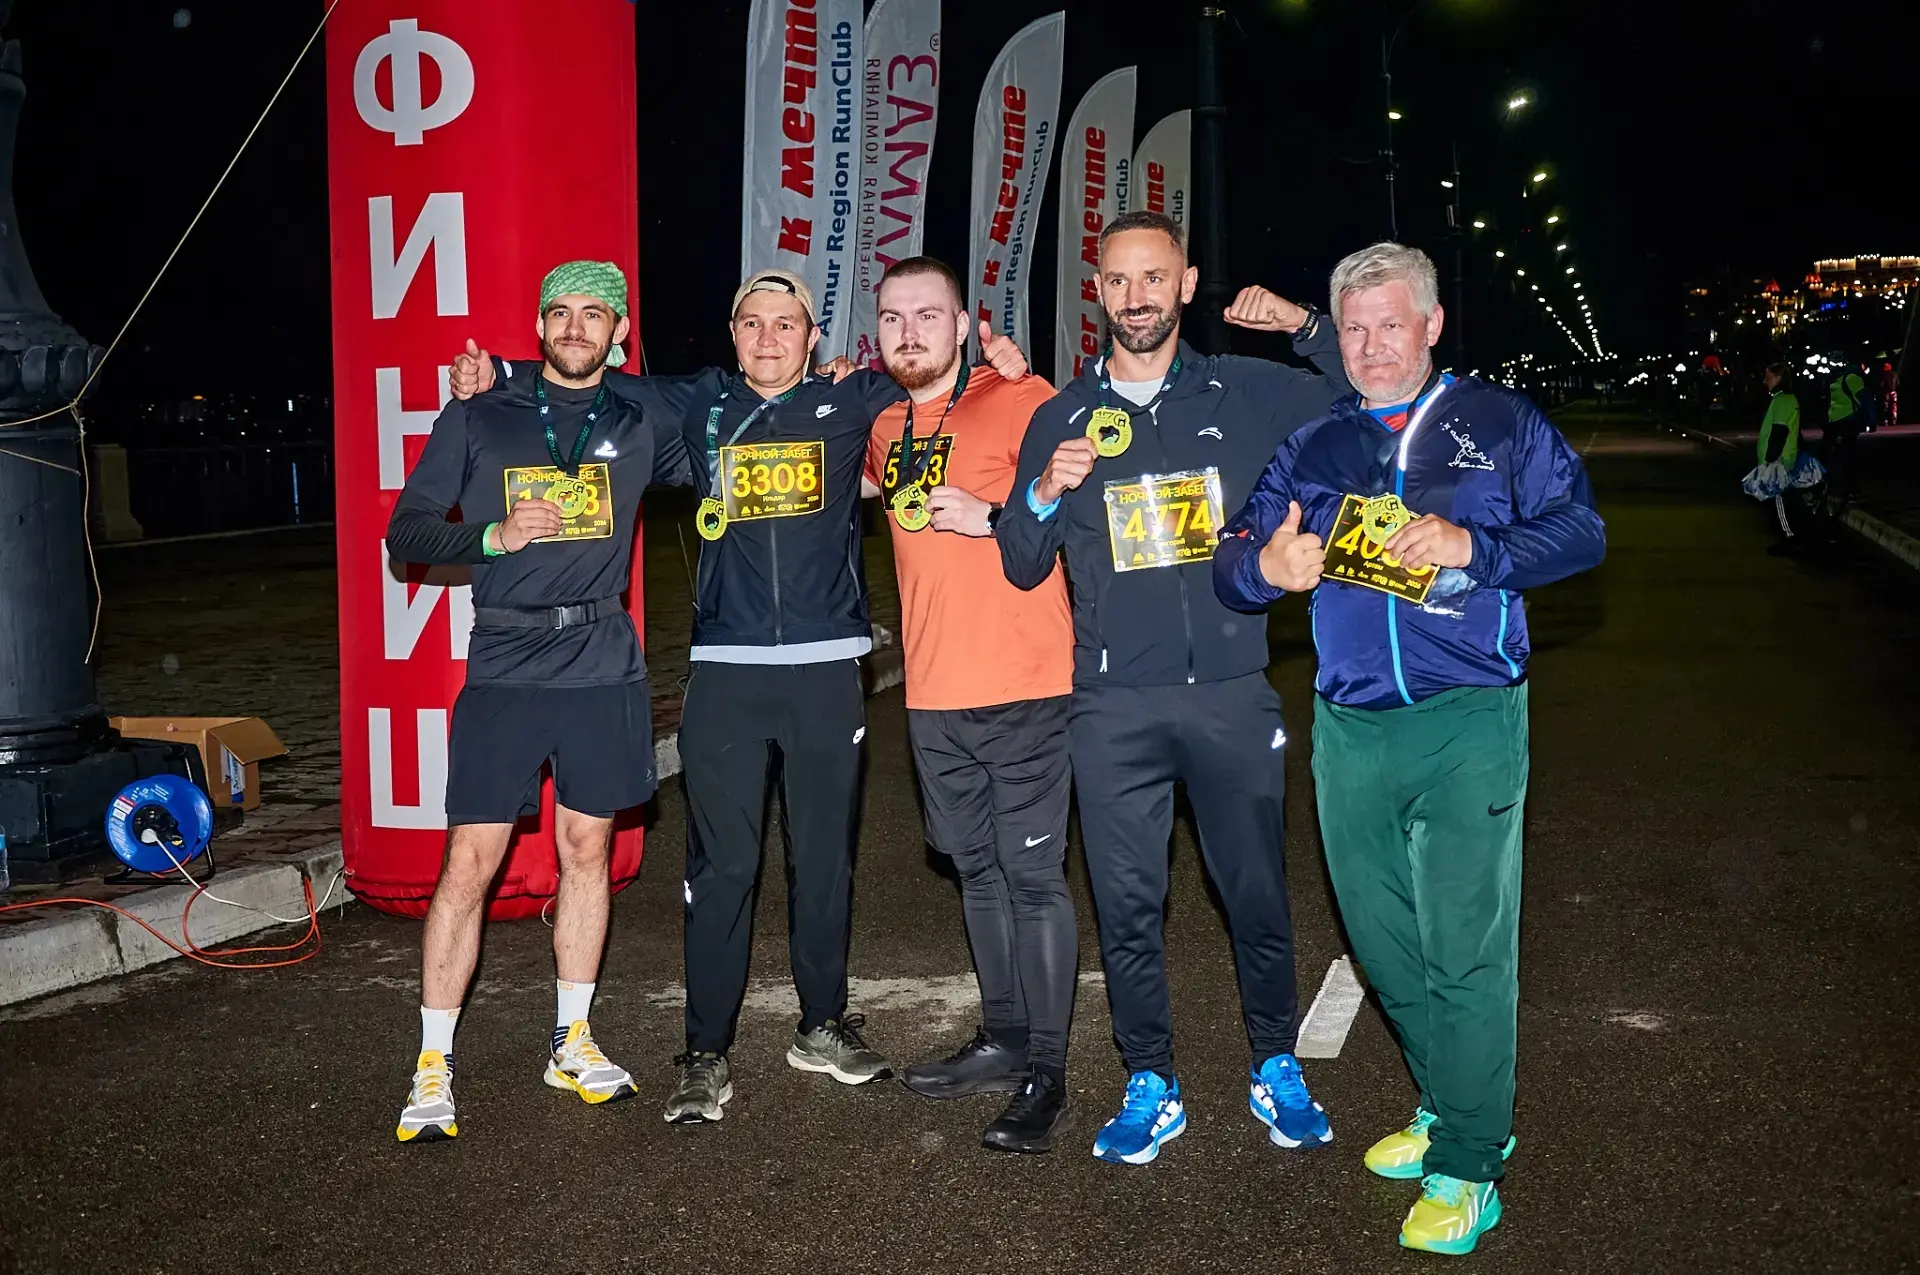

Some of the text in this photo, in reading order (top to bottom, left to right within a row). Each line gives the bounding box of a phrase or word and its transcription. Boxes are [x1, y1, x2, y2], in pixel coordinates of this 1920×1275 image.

[777, 0, 819, 256] к мечт
[818, 20, 853, 338] Amur Region RunClub
[983, 85, 1027, 287] к мечте
[1081, 126, 1106, 268] мечте
[1115, 158, 1130, 216] nClub
[1005, 209, 1028, 283] Region
[1022, 121, 1049, 201] RunClub
[1081, 278, 1097, 304] к
[353, 18, 475, 830] ФИНИШ
[731, 462, 818, 498] 3308
[884, 454, 943, 489] 53
[1121, 499, 1214, 543] 4774
